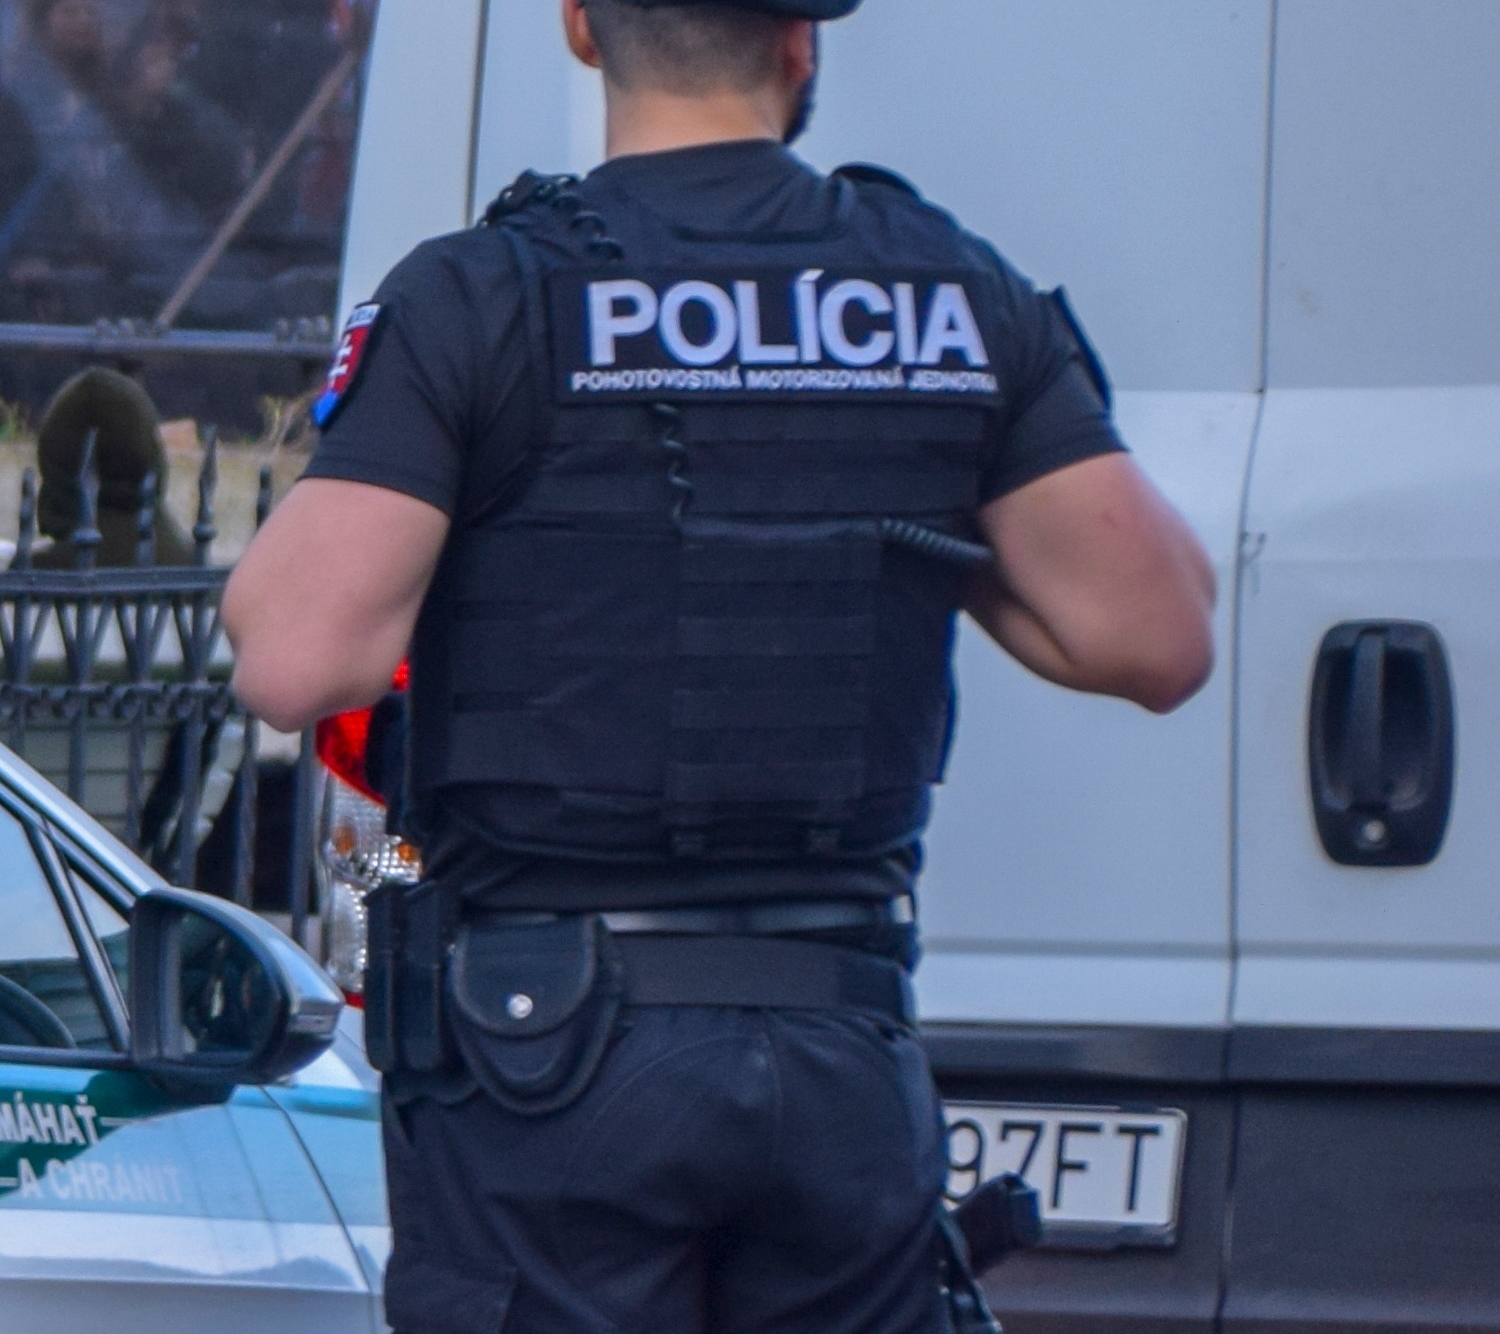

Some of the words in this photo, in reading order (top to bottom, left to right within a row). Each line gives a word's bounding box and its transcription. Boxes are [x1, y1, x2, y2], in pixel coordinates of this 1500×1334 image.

[589, 269, 988, 366] POLÍCIA
[572, 366, 742, 392] POHOTOVOSTNÁ
[18, 1158, 43, 1199] A
